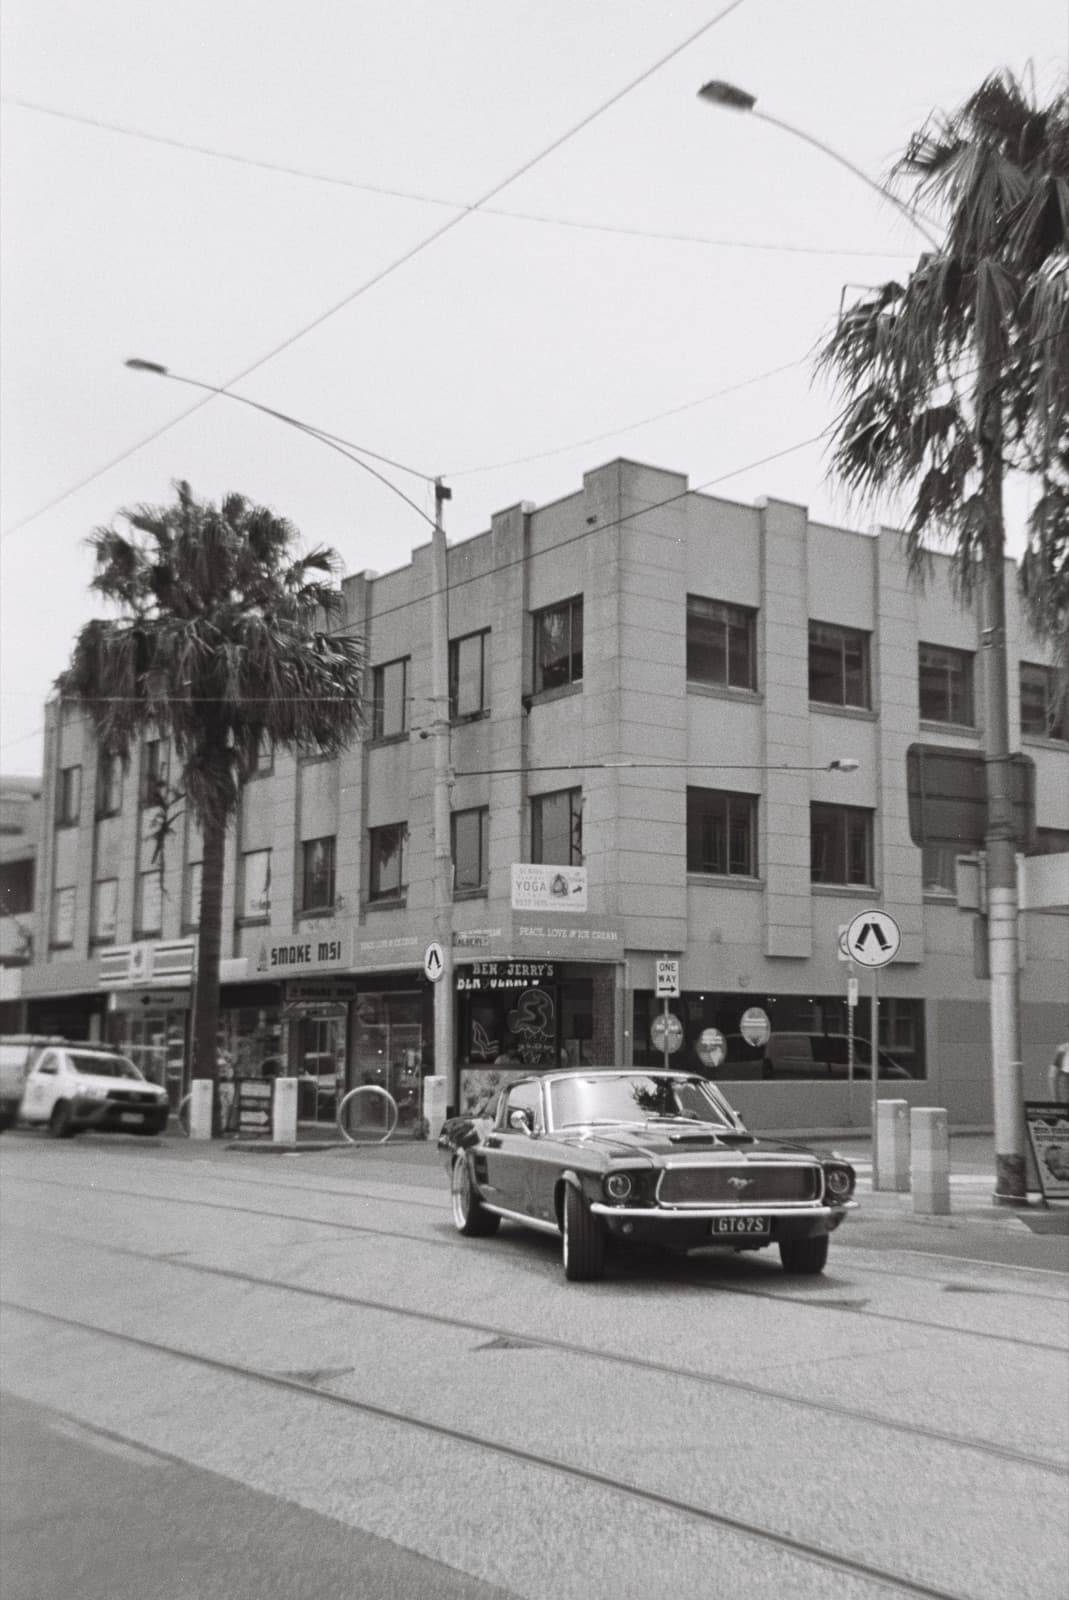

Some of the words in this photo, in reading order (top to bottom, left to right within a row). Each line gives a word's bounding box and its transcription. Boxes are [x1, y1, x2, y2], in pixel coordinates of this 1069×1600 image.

[516, 881, 547, 892] YOGA
[547, 927, 567, 938] LOVE
[591, 930, 618, 940] CREAM
[271, 944, 311, 966] SMOKE
[318, 941, 341, 961] MSI
[472, 963, 497, 975] BEN
[507, 963, 553, 976] JERRY'S
[659, 962, 677, 972] ONE
[658, 975, 677, 984] WAY
[719, 1217, 764, 1232] GT67S
